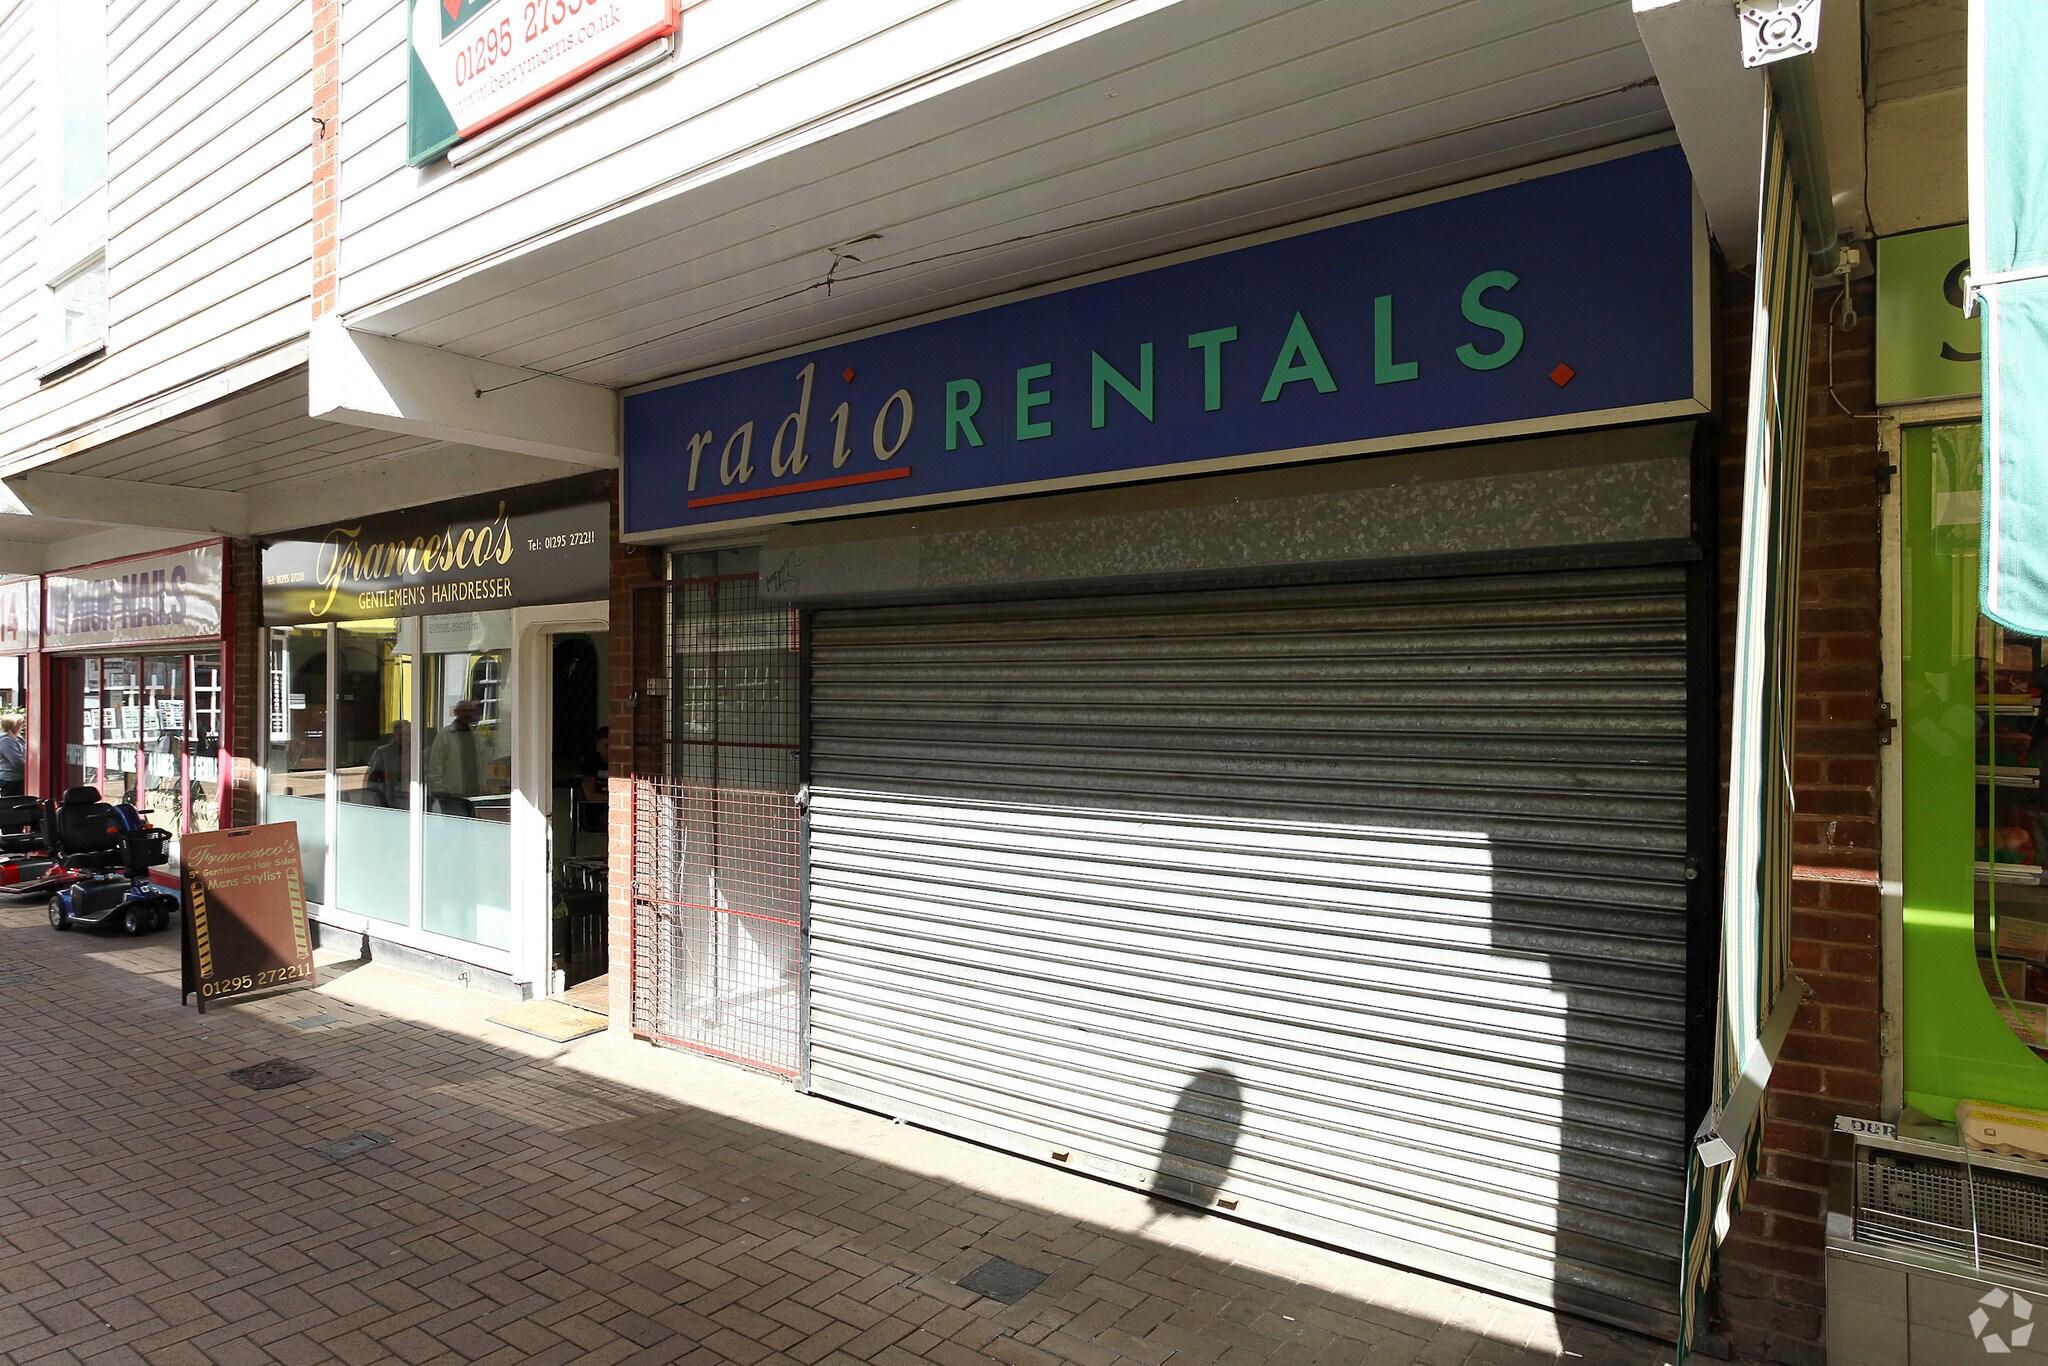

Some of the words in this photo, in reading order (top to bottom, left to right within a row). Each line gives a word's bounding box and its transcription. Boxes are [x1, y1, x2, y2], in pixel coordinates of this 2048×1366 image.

[456, 17, 512, 87] 01295
[685, 362, 916, 492] radio
[528, 538, 541, 551] Tel:
[545, 535, 566, 550] 01295
[570, 531, 595, 546] 272211
[309, 500, 514, 617] Francesco's
[122, 565, 187, 629] NAILS
[358, 586, 425, 609] GENTLEMEN'S
[432, 577, 512, 602] HAIRDRESSER
[188, 839, 296, 868] Francesco's
[203, 863, 252, 877] Gentlemans
[254, 861, 271, 870] Hair
[275, 858, 297, 867] Salon
[208, 877, 239, 890] Mens
[243, 871, 282, 885] Stylist
[202, 975, 253, 997] 01295
[258, 963, 312, 985] 272211
